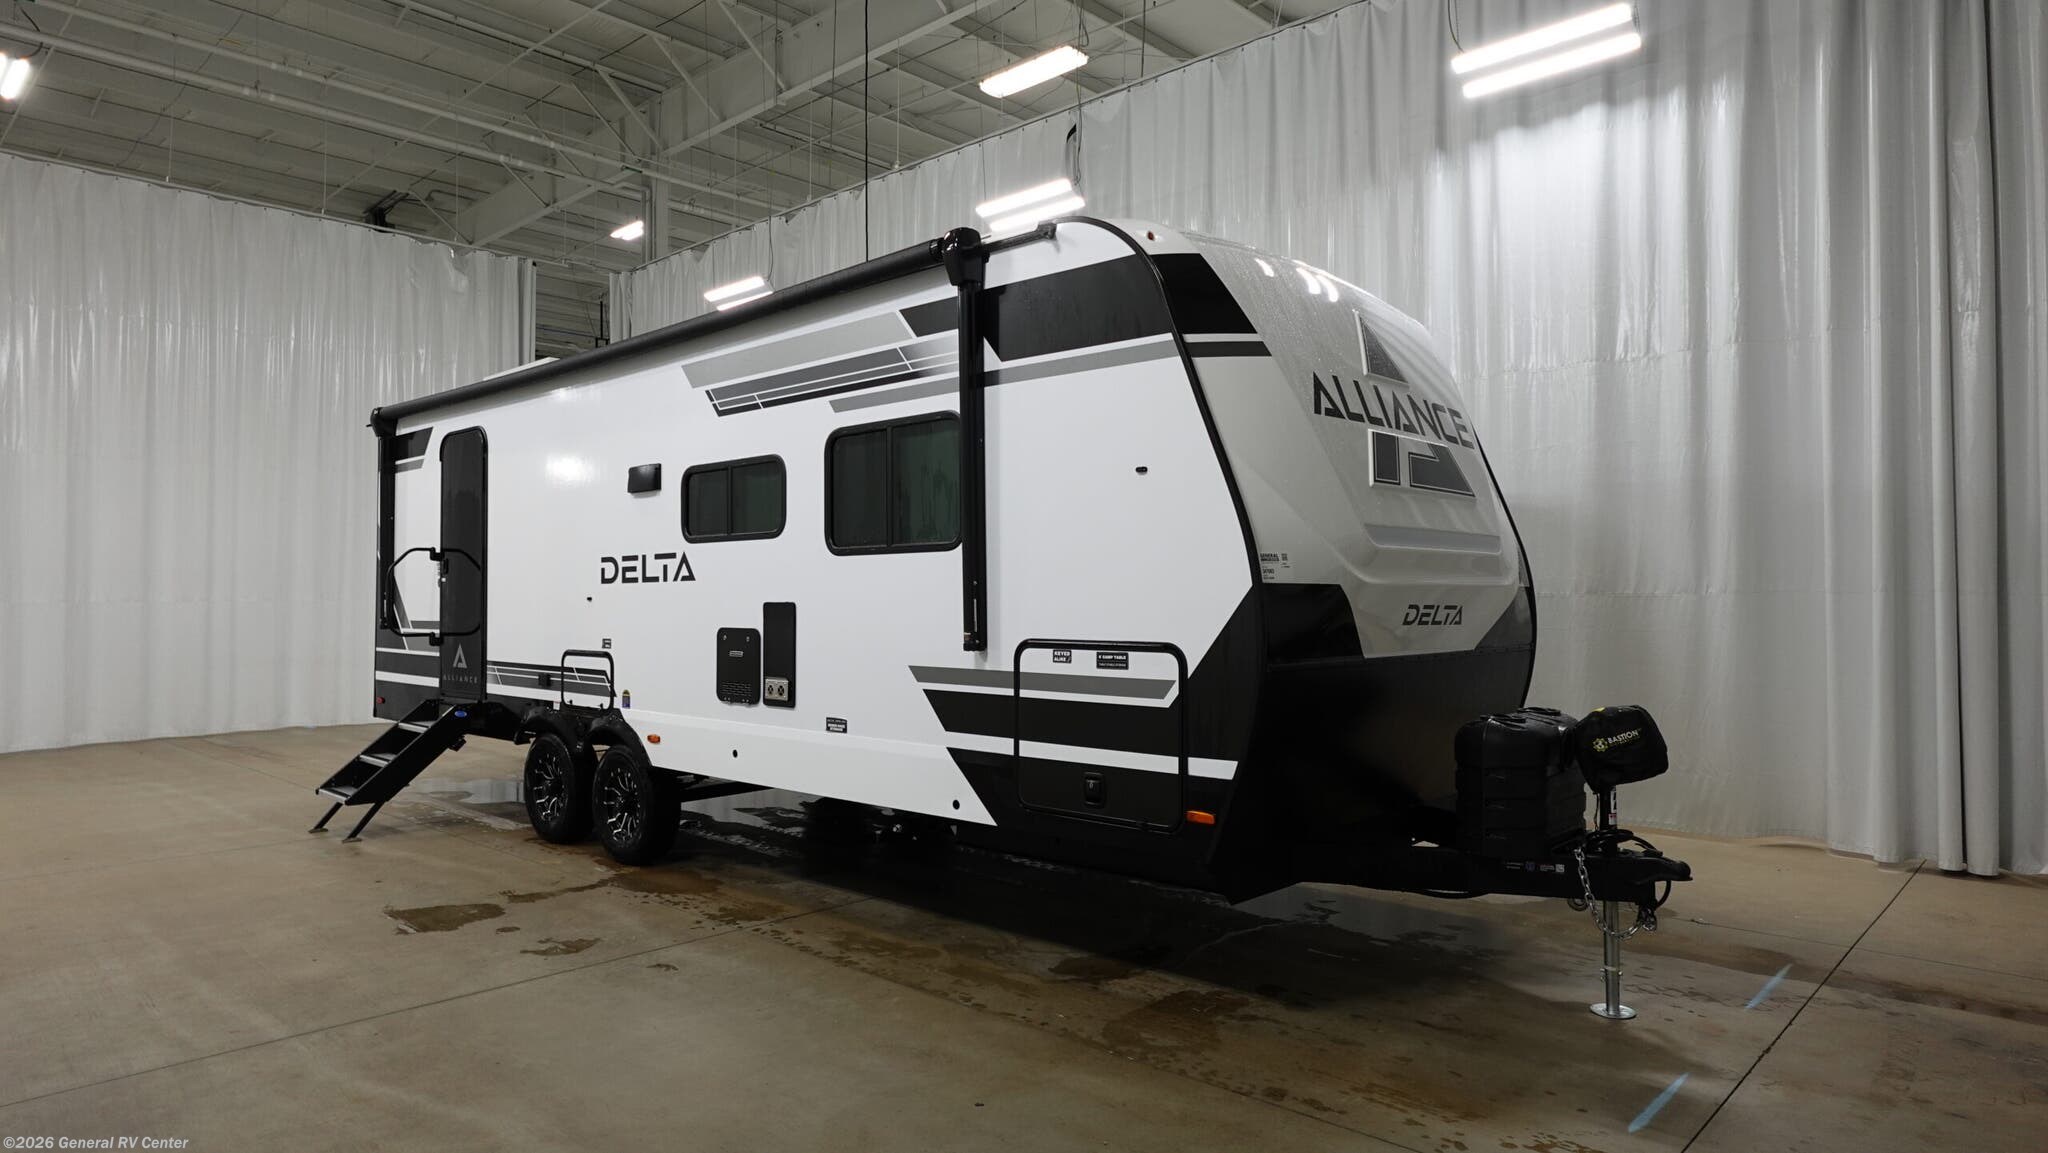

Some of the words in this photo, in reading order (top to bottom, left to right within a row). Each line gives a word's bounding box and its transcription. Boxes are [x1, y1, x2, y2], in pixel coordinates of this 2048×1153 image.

[1313, 371, 1475, 450] ALLIANCE
[600, 551, 696, 585] DELTA
[1402, 604, 1463, 626] DELTA
[443, 674, 477, 684] ALLIANCE
[1607, 729, 1639, 744] BASTION
